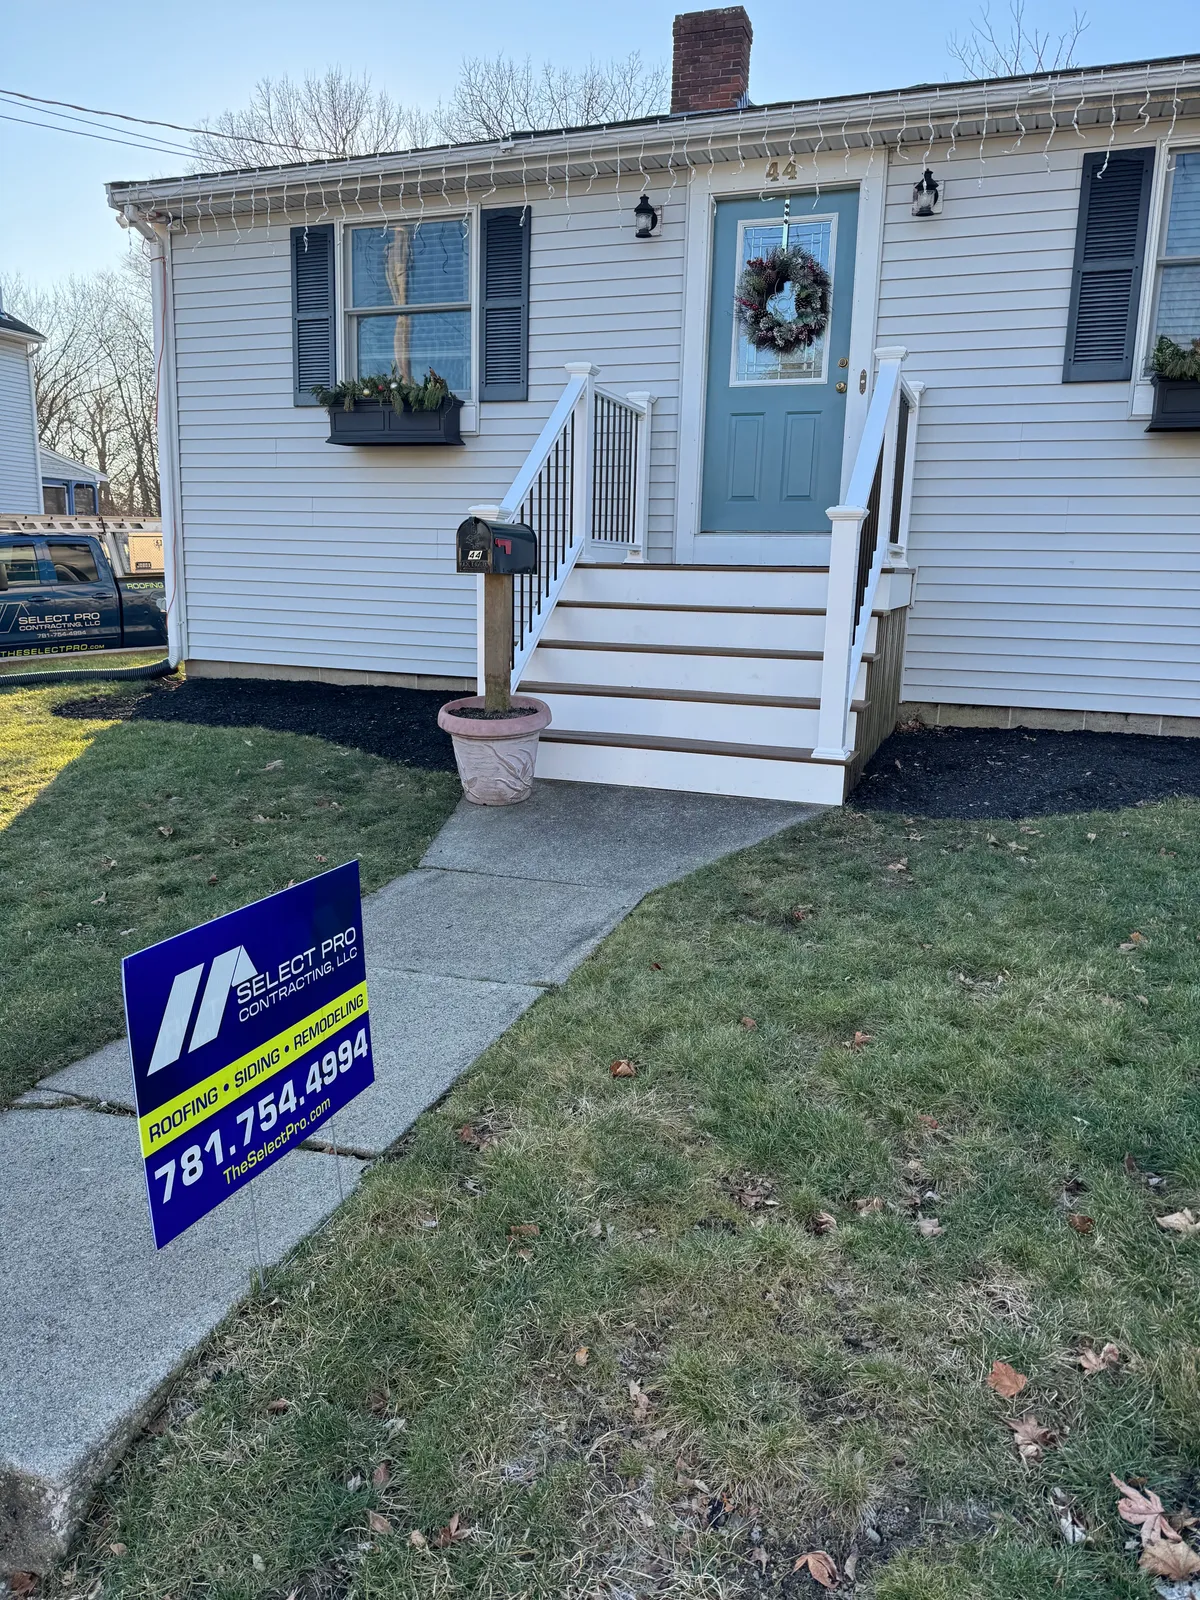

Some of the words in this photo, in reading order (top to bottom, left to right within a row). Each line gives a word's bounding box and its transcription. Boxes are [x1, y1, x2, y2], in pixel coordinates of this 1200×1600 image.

[766, 160, 797, 181] 44
[126, 581, 164, 590] ROOFING
[18, 614, 70, 625] SELECT
[74, 612, 100, 621] PRO
[19, 622, 83, 631] CONTRACTING,
[0, 644, 105, 658] THESELECTPRO.COM
[236, 948, 316, 1004] SELECT
[320, 926, 356, 960] PRO
[238, 961, 335, 1022] CONTRACTING,
[336, 947, 358, 968] LLC
[149, 1087, 219, 1143] ROOFING
[234, 1047, 280, 1088] SIDING
[293, 993, 364, 1050] REMODELING
[154, 1028, 368, 1204] 781.754.4994
[223, 1097, 331, 1185] TheSelectPro.com
